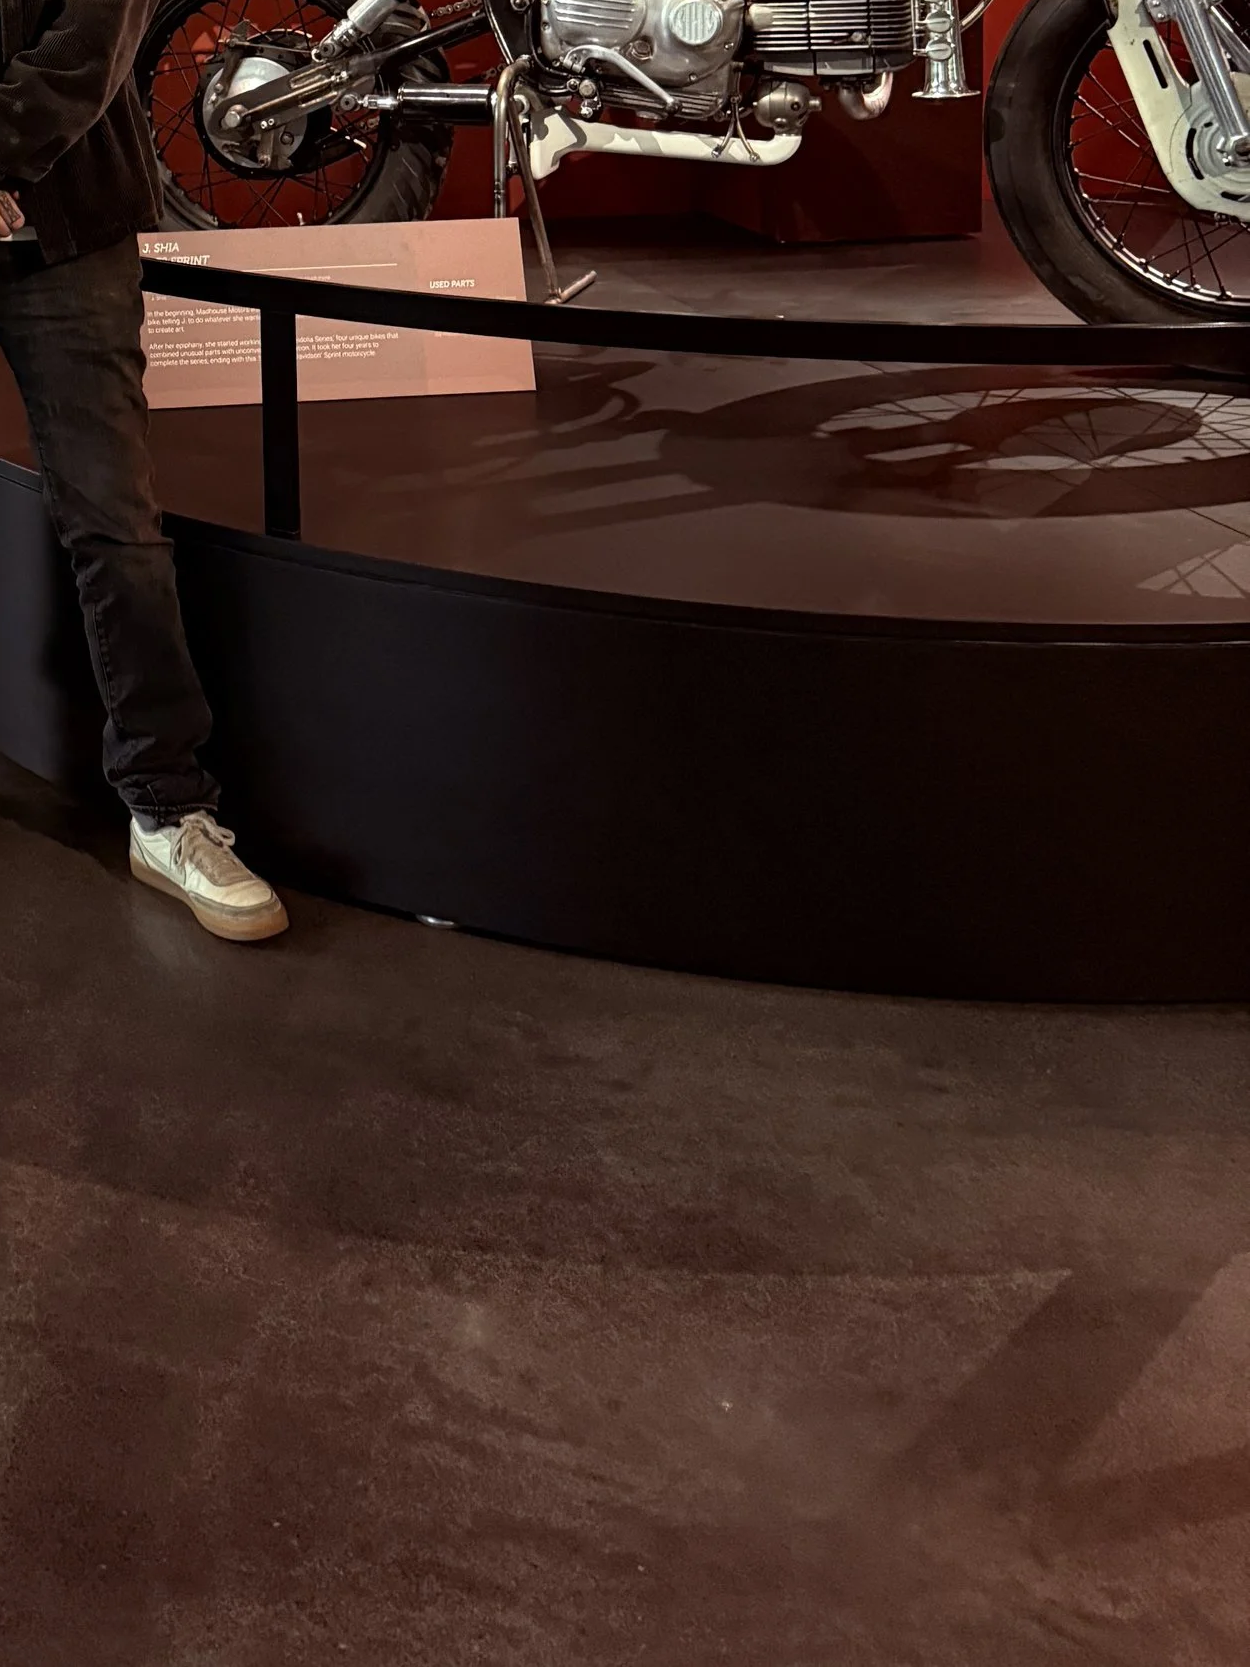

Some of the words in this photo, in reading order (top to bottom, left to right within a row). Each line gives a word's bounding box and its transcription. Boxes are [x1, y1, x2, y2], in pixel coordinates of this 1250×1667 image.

[142, 243, 151, 254] J.
[153, 242, 180, 253] SHIA
[429, 280, 450, 289] USED
[451, 279, 475, 288] PARTS
